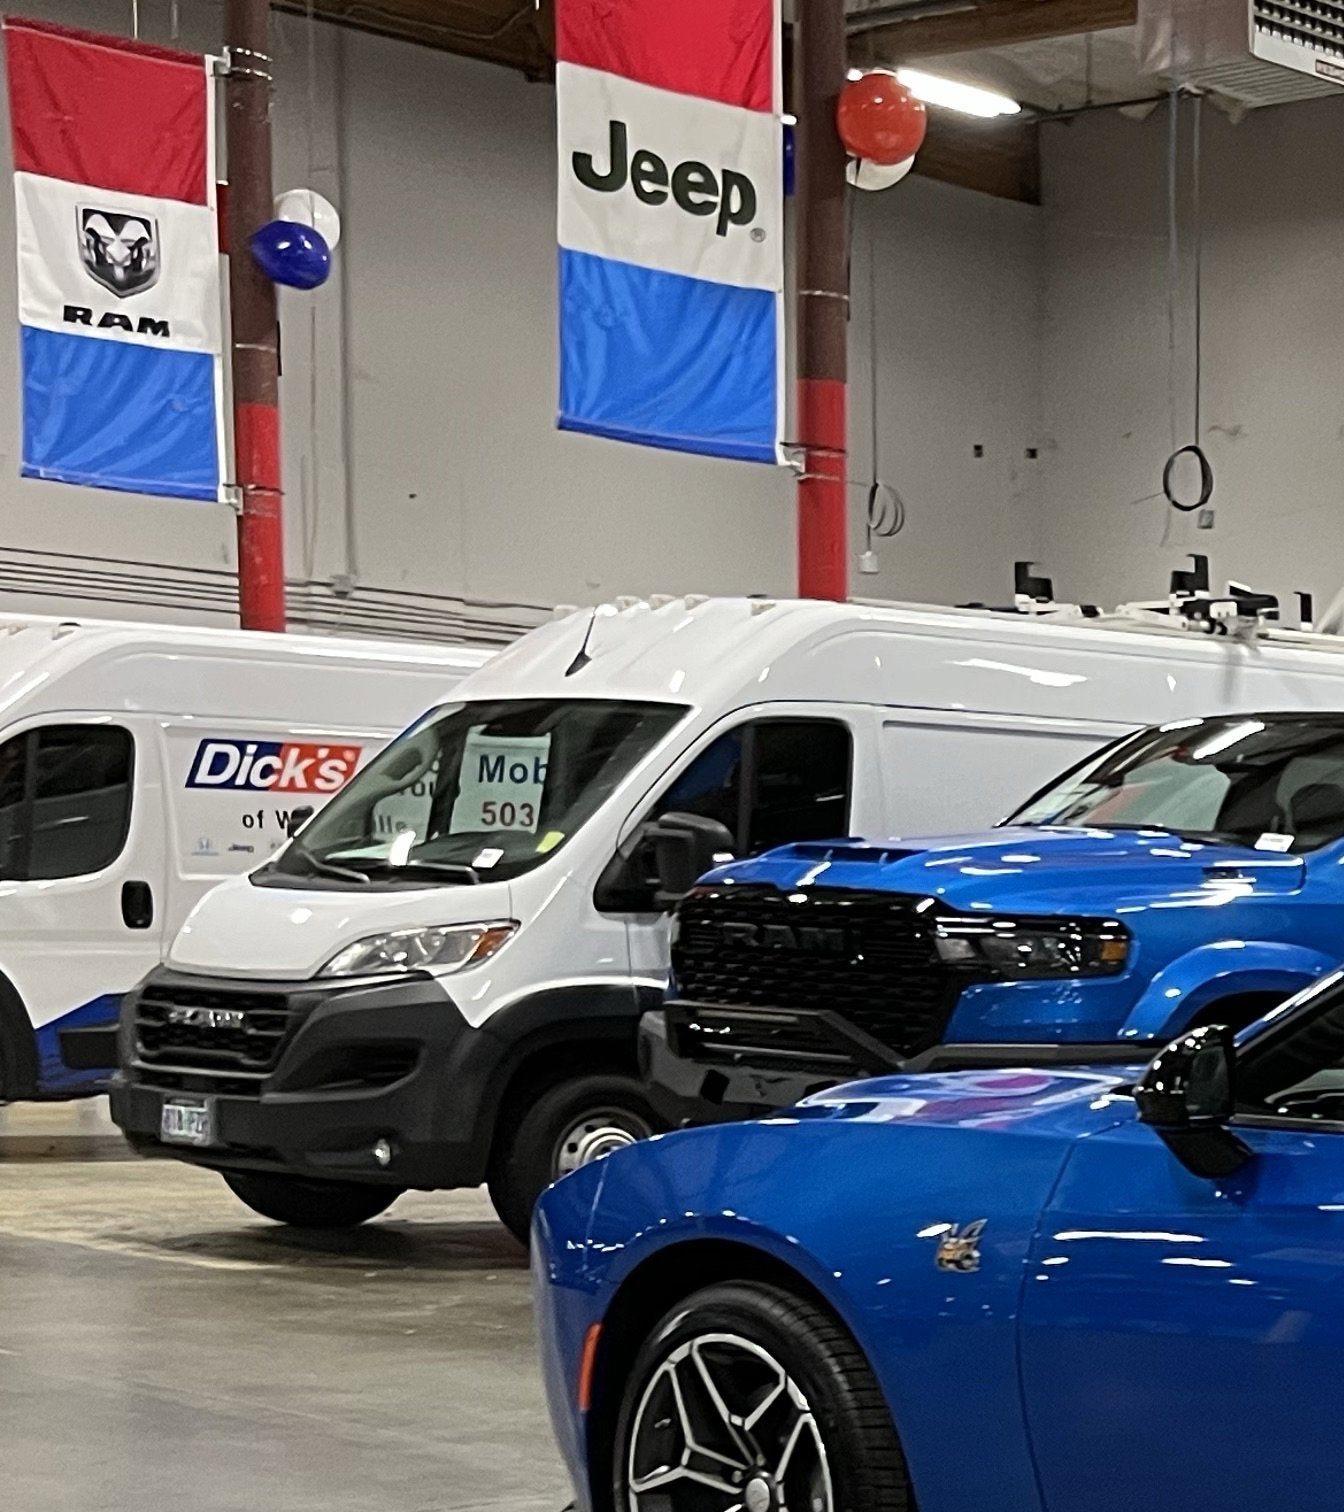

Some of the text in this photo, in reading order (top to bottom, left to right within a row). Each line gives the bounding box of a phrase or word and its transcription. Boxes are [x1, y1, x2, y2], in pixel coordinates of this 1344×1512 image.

[571, 119, 757, 237] Jeep
[63, 304, 170, 338] RAM
[194, 742, 348, 791] Dick's
[242, 810, 264, 829] of
[481, 801, 534, 827] 503
